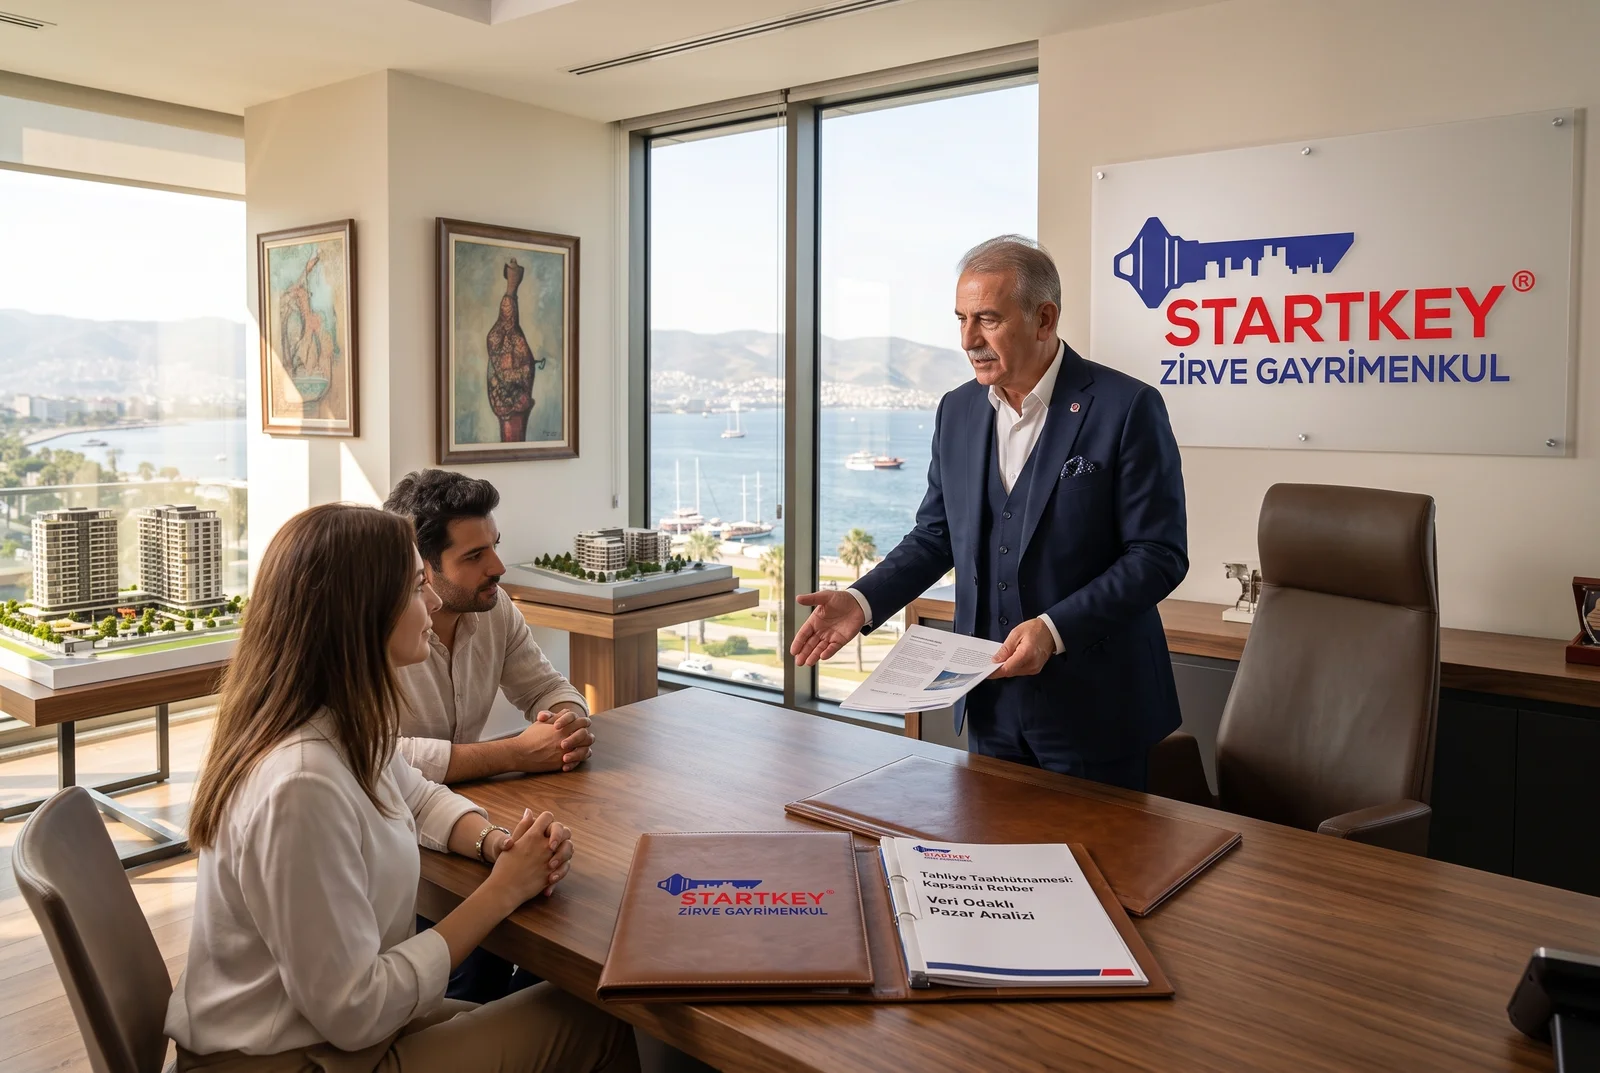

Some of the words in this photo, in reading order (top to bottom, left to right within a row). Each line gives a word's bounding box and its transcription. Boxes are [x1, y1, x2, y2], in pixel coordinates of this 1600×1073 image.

[1160, 352, 1247, 385] ZİRVE
[1256, 349, 1510, 384] GAYRİMENKUL
[920, 871, 967, 881] Tahliye
[969, 874, 1074, 884] Taahhütnamesi:
[987, 884, 1035, 892] Rehber
[927, 896, 958, 906] Veri
[963, 898, 1014, 909] Odaklı
[678, 905, 720, 916] ZİRVE
[725, 905, 828, 916] GAYRİMENKUL
[930, 907, 975, 918] Pazar
[980, 910, 1035, 920] Analizi
